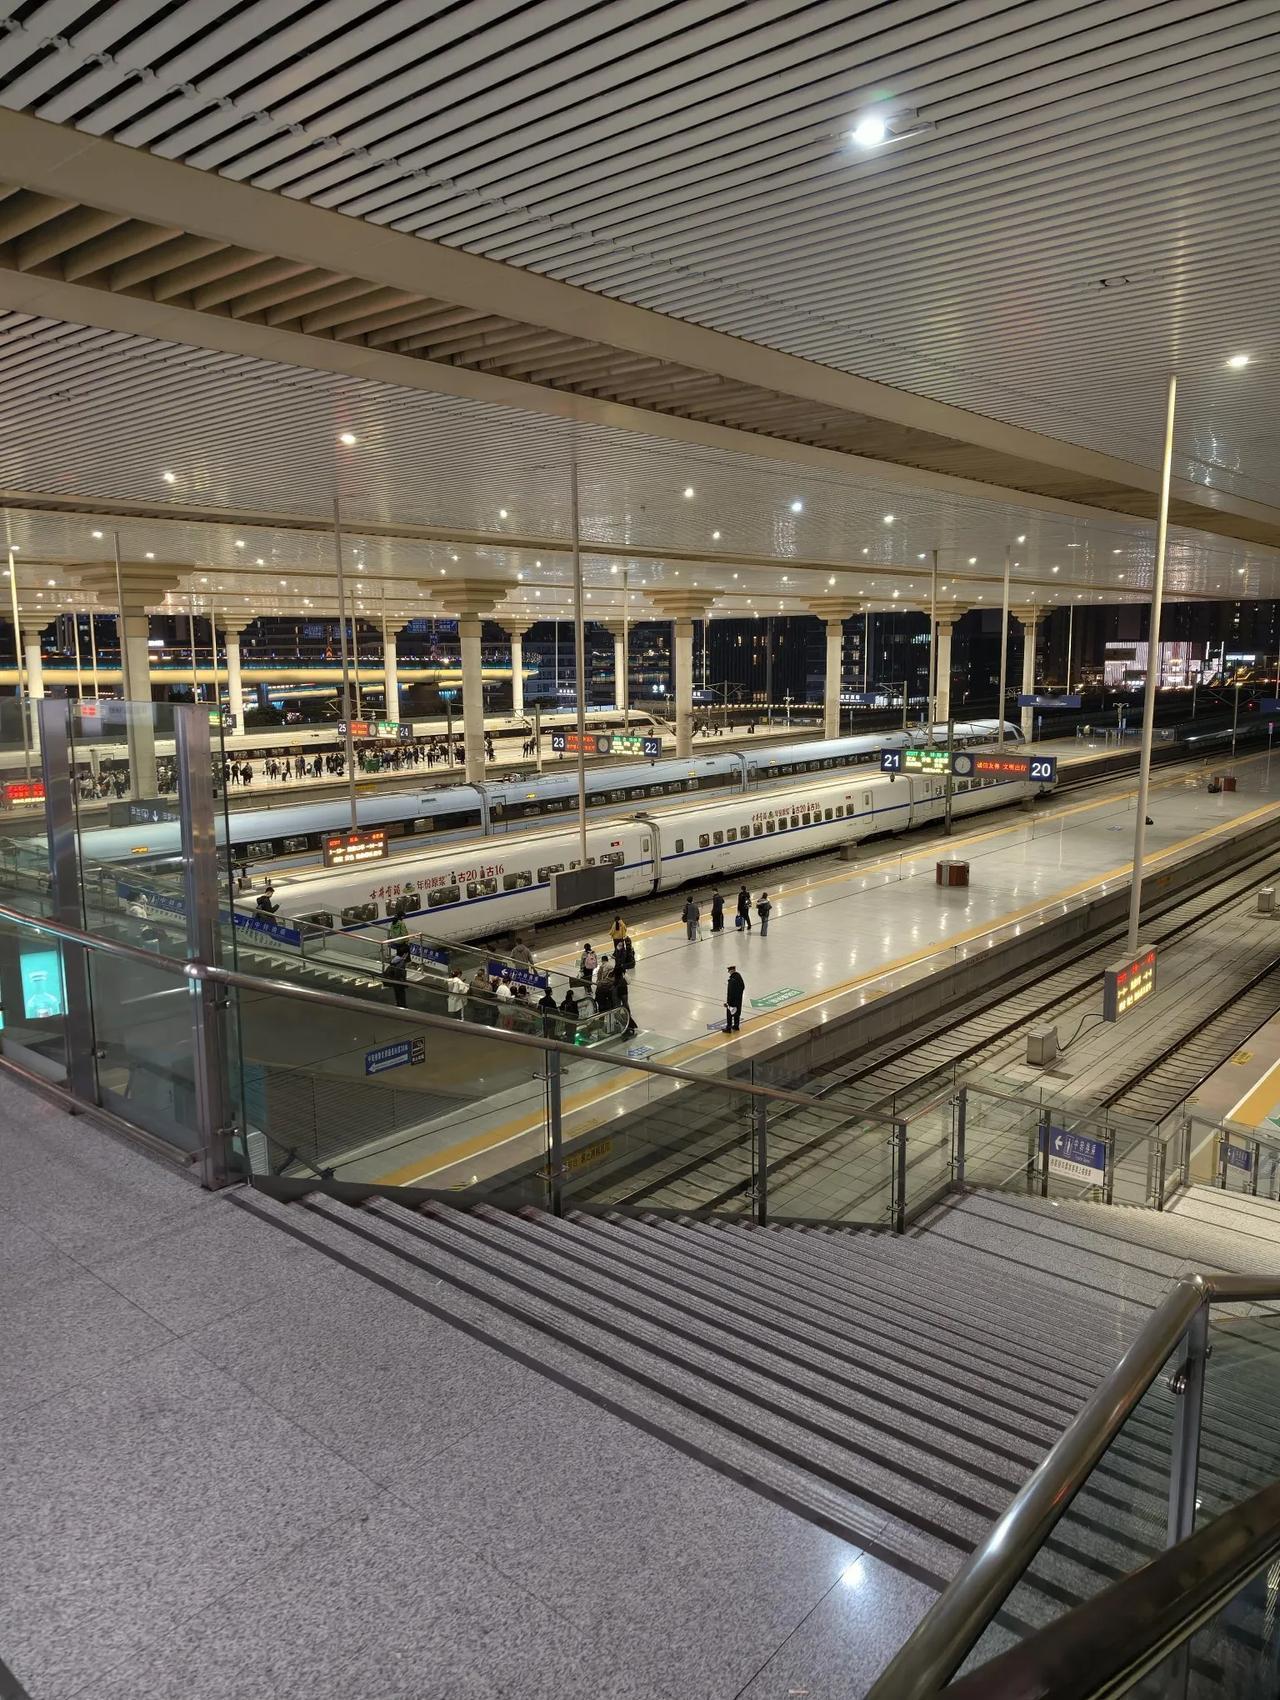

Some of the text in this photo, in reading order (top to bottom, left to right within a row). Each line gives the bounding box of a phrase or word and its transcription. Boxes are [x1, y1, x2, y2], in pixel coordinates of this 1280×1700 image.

[338, 723, 347, 732] 25
[400, 727, 409, 737] 24
[553, 736, 565, 748] 23
[645, 742, 657, 754] 22
[883, 754, 900, 767] 21
[1031, 762, 1051, 777] 20
[458, 869, 478, 883] 古20
[486, 864, 505, 877] 古16
